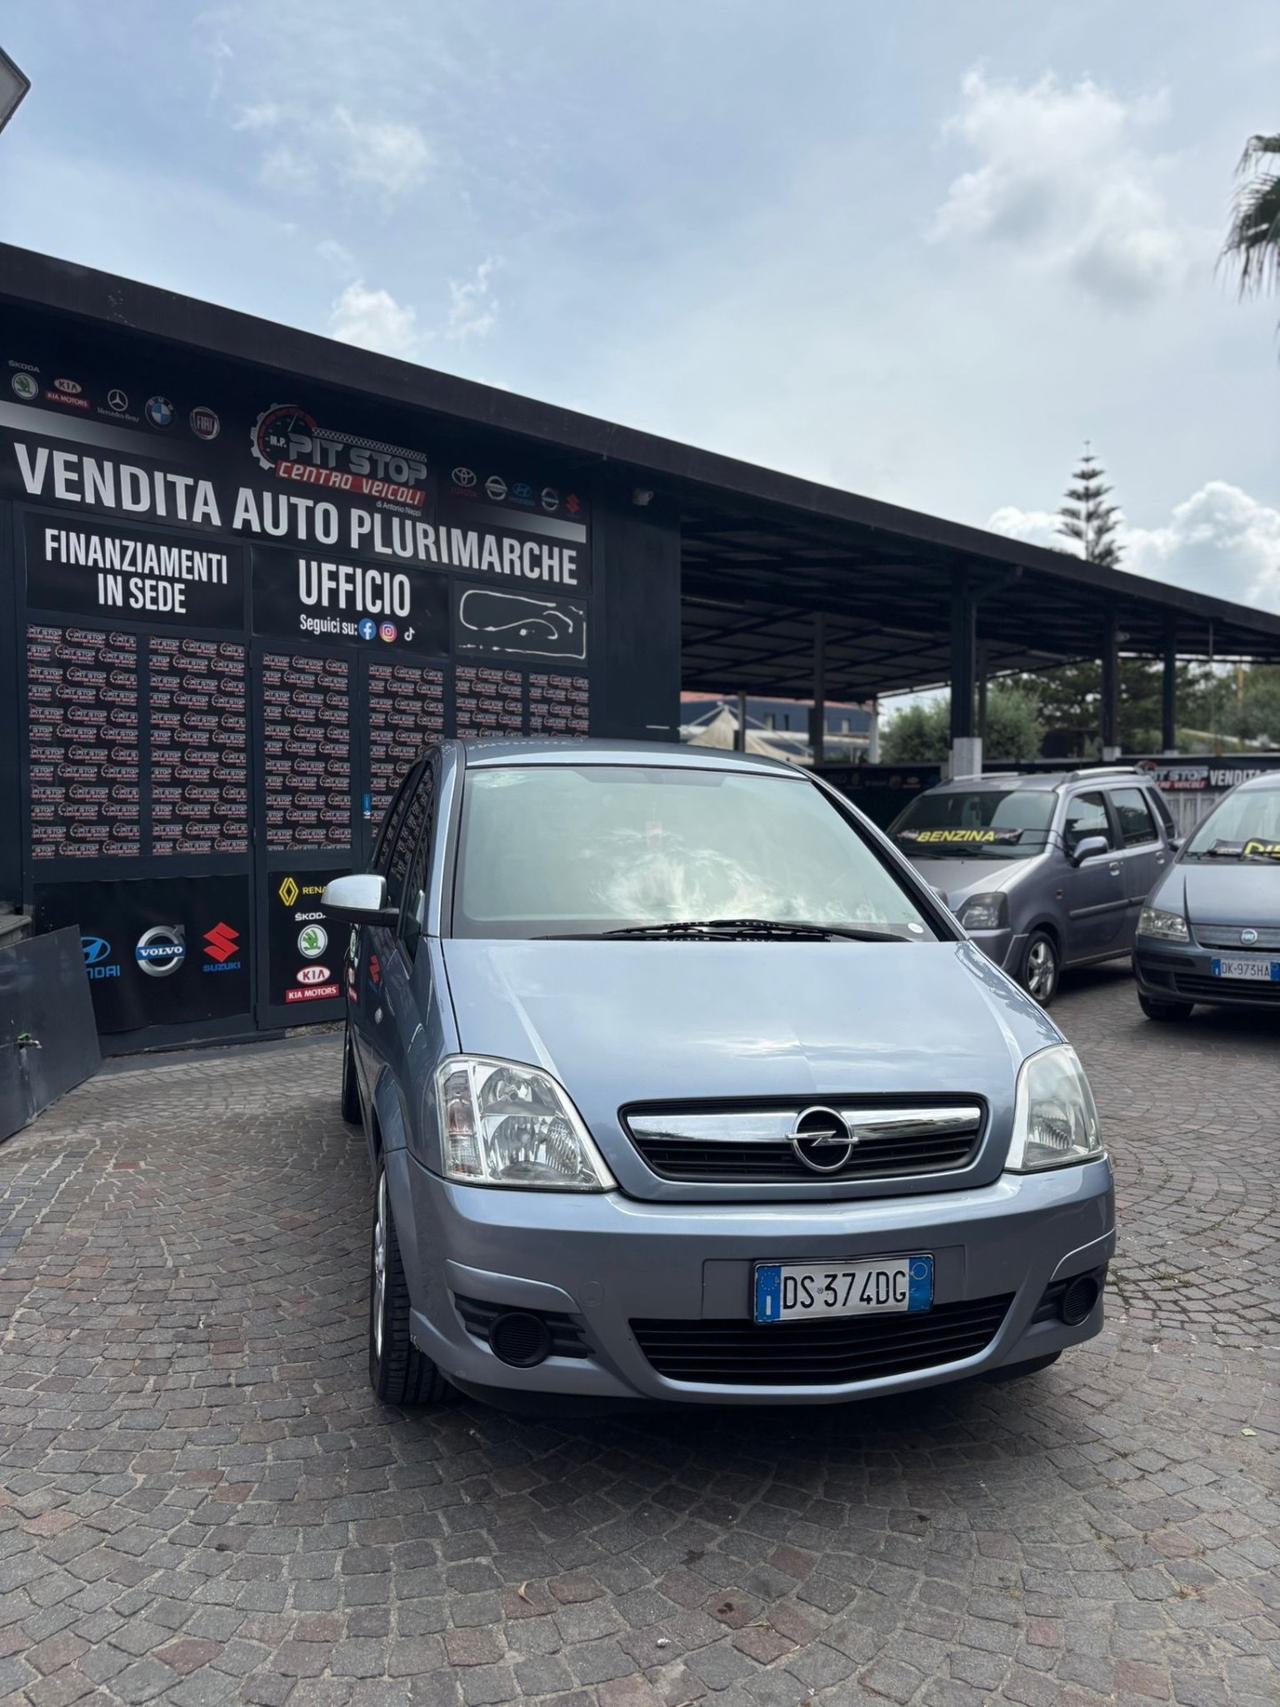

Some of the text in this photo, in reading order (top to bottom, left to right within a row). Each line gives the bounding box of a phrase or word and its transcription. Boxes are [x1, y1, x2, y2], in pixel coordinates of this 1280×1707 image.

[59, 380, 78, 392] KIA
[61, 395, 89, 407] MOTORS
[288, 433, 428, 486] PIT STOP
[13, 442, 577, 586] VENDITA AUTO PLURIMARCHE
[45, 528, 228, 585] FINANZIAMENTI
[98, 573, 187, 614] IN SEDE
[299, 559, 411, 617] UFFICIO
[300, 614, 358, 636] Seguici su:
[1169, 769, 1209, 781] STOP
[917, 830, 996, 842] BENZINA
[140, 945, 184, 957] VOLVO
[202, 961, 241, 973] SUZUKI
[302, 969, 326, 981] KIA
[288, 986, 337, 999] KIA MOTORS
